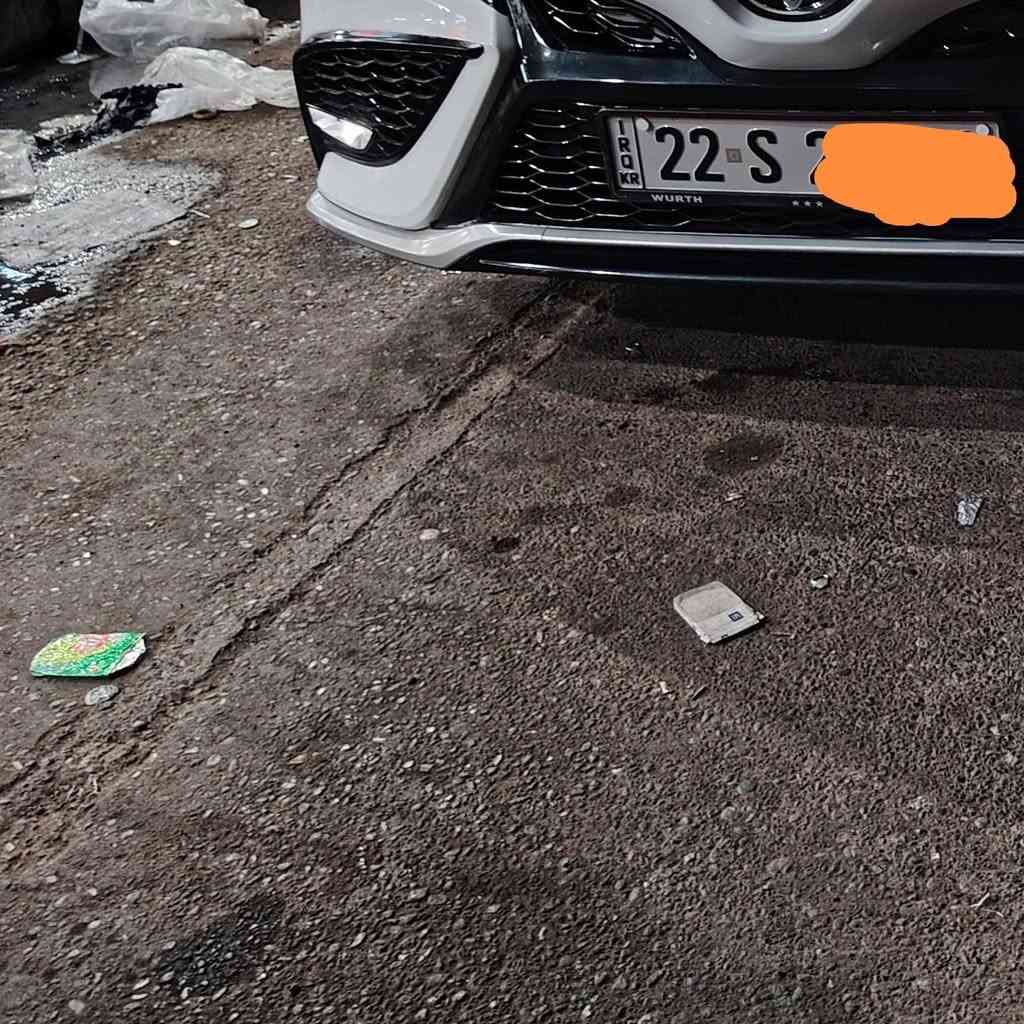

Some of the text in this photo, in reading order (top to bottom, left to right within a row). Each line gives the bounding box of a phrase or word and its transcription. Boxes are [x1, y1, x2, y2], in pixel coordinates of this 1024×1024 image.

[655, 126, 725, 182] 22
[747, 130, 782, 184] S
[620, 172, 640, 185] KR
[651, 193, 703, 204] WURTH
